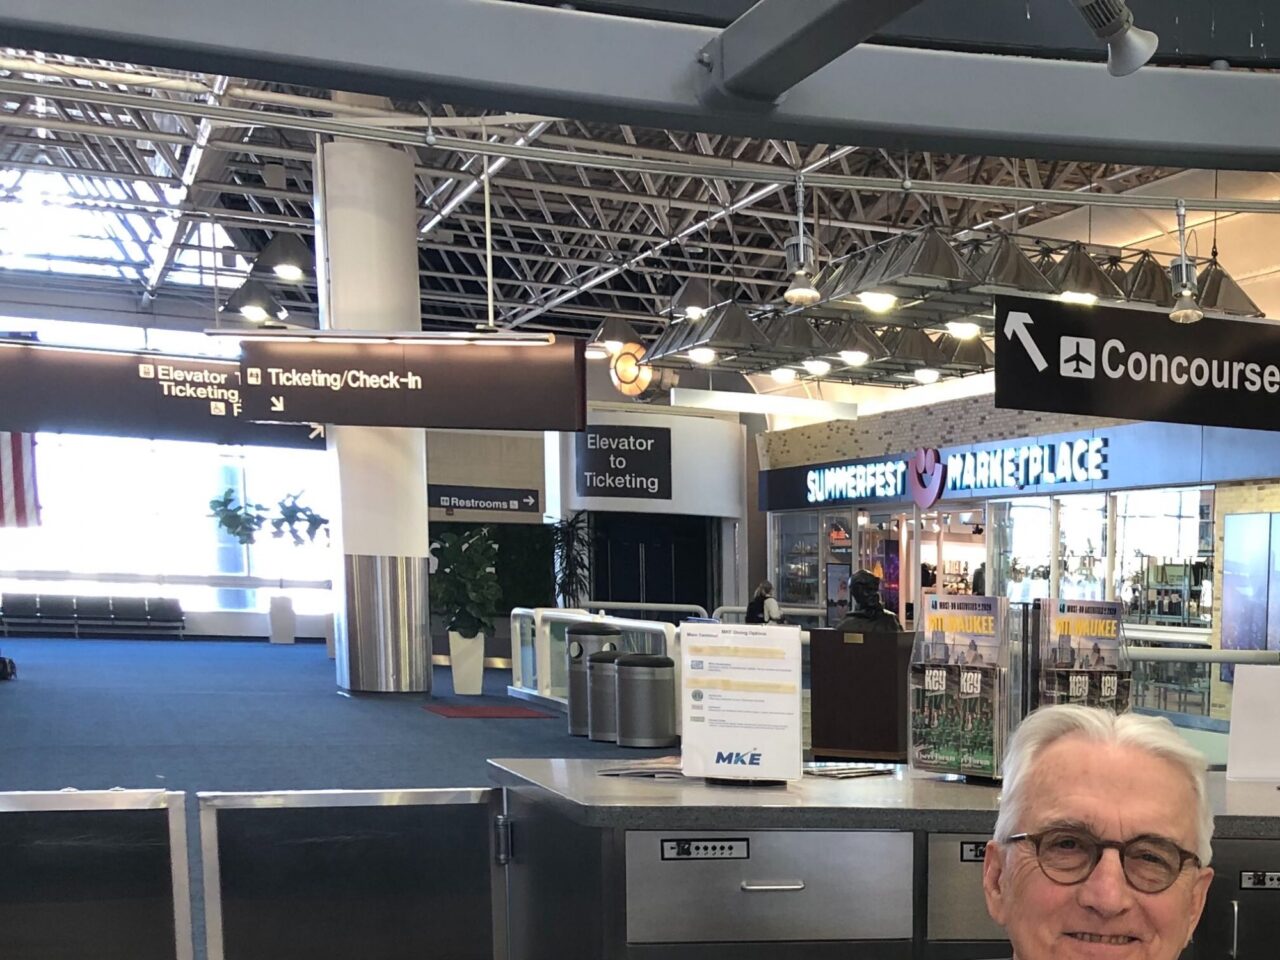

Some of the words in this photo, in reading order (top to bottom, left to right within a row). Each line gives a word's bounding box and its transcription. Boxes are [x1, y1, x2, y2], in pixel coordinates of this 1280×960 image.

[157, 365, 228, 384] Elevator
[1101, 338, 1280, 393] Concourse
[267, 368, 422, 390] Ticketing/Check-In
[160, 381, 242, 403] Ticketing
[587, 434, 655, 451] Elevator
[609, 454, 627, 469] to
[806, 460, 907, 503] SUMMERFEST
[947, 437, 1107, 491] MARKETPLACE
[584, 472, 659, 493] Ticketing
[451, 497, 508, 510] Restrooms
[928, 614, 995, 634] MILWAUKEE
[1055, 618, 1118, 637] MILWAUKEE
[715, 751, 762, 765] MKE
